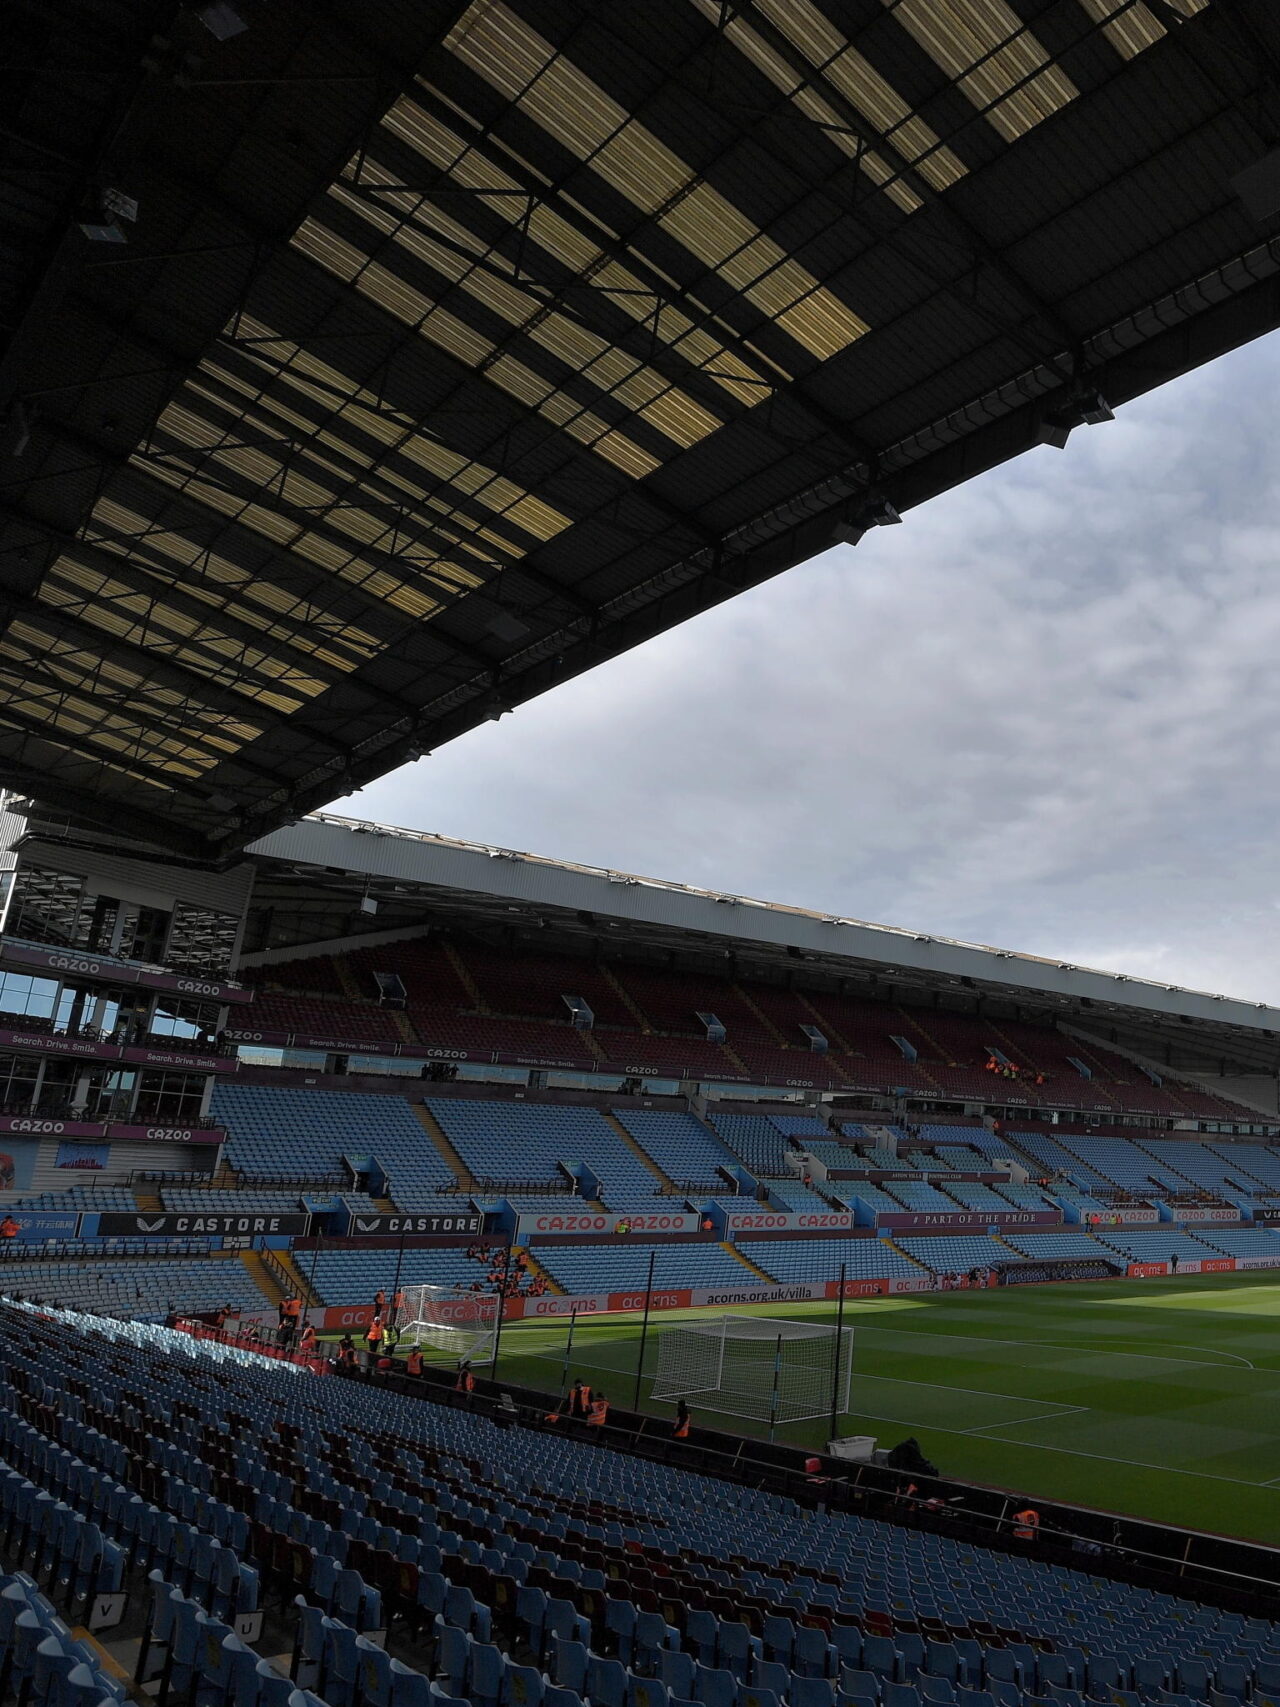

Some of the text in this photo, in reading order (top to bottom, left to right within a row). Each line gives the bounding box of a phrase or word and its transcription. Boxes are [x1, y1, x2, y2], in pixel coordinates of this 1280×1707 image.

[48, 955, 100, 973] CAZOO
[177, 980, 220, 996] CAZOO
[222, 1029, 263, 1041] AZOO
[12, 1035, 97, 1054] Search. Drive. Smile.
[309, 1039, 335, 1048] Search.
[147, 1052, 218, 1068] Search. Drive. Smile.
[427, 1049, 468, 1060] CAZOO
[625, 1066, 658, 1075] CAZOO
[786, 1079, 814, 1087] CAZOO
[10, 1119, 65, 1133] CAZOO
[146, 1128, 192, 1140] CAZOO
[925, 1215, 953, 1224] PART
[958, 1214, 973, 1223] OF
[978, 1214, 999, 1223] THE
[1124, 1212, 1155, 1221] CAZOO
[1176, 1210, 1238, 1219] CAZOO CAZOO
[176, 1217, 280, 1232] CASTORE
[389, 1218, 478, 1231] CASTORE
[536, 1216, 606, 1231] CAZOO
[731, 1215, 849, 1228] CAZOO CAZOO
[707, 1286, 812, 1304] acorns.org.uk/villa
[536, 1298, 597, 1314] acorns
[101, 1604, 112, 1616] V
[242, 1622, 252, 1634] U
